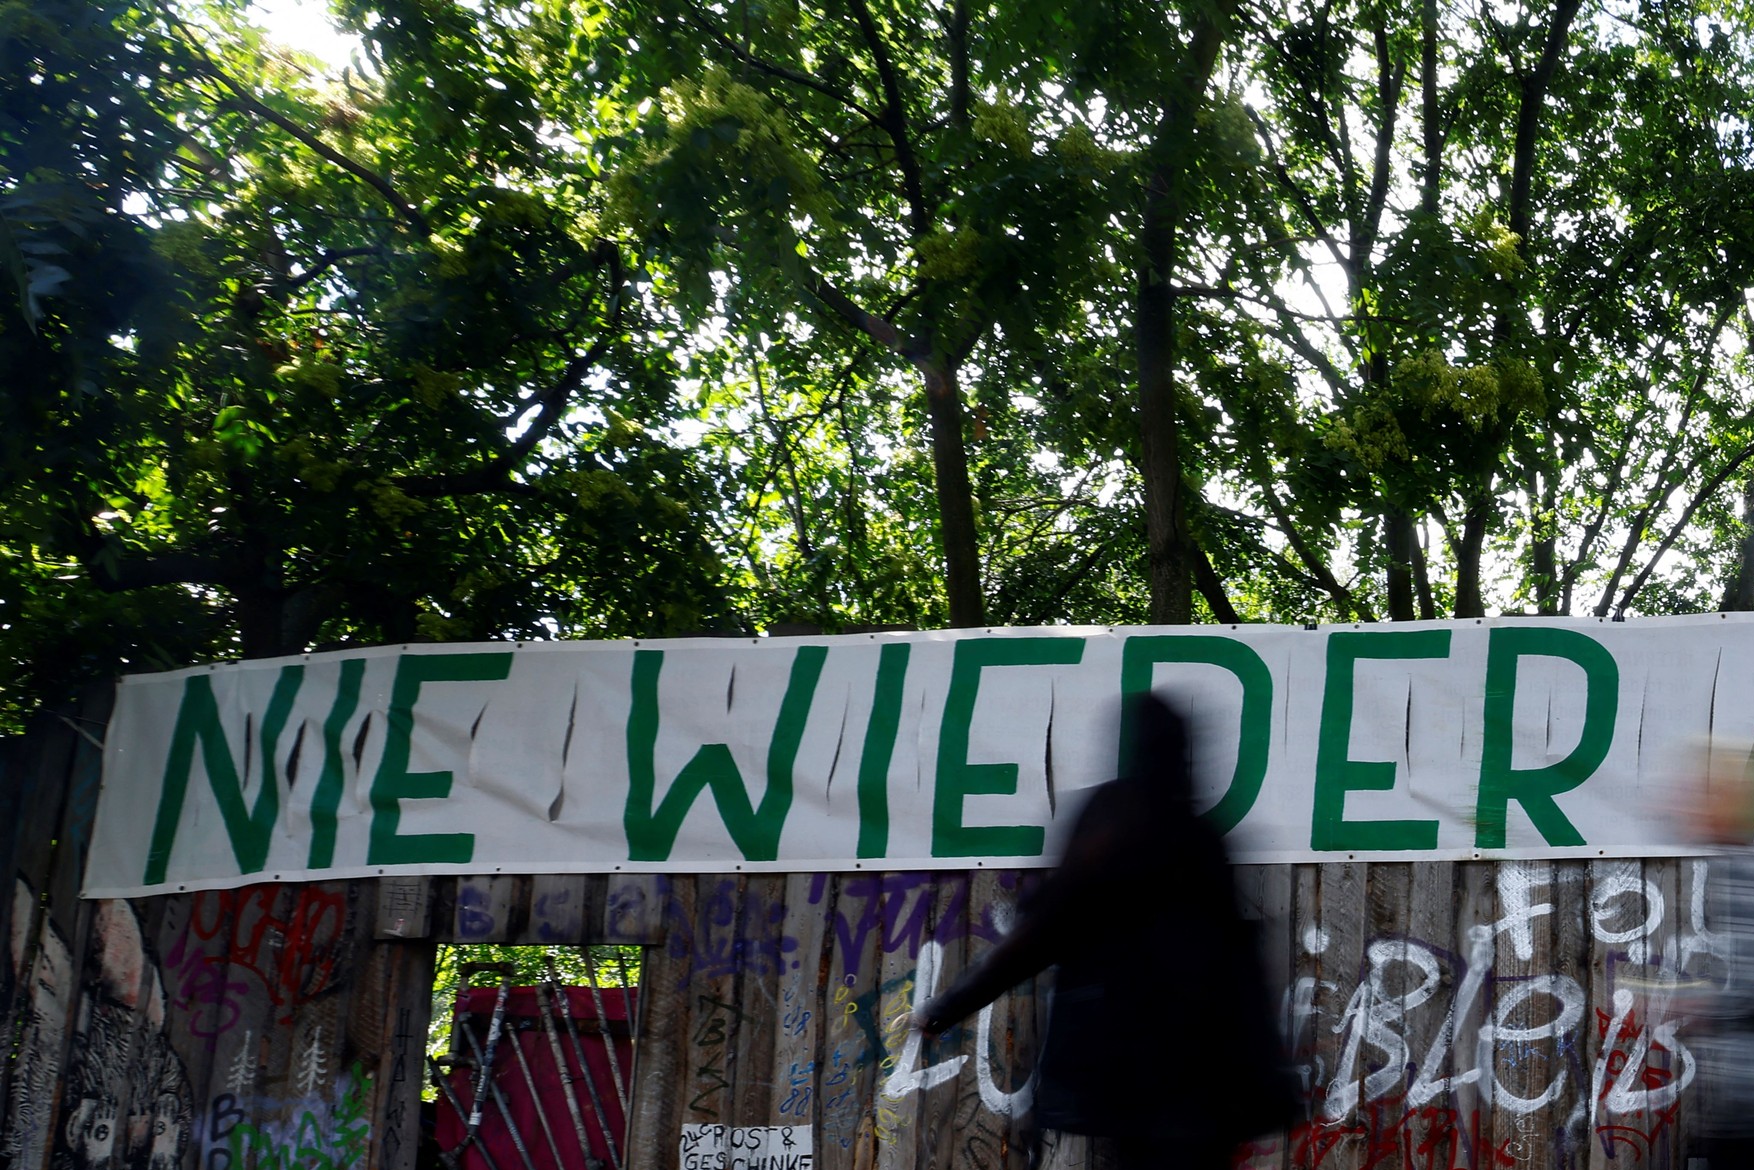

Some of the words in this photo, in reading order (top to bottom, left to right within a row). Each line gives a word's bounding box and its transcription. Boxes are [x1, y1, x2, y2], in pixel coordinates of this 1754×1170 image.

[143, 651, 514, 886] NIE
[621, 627, 1620, 863] WIEDER
[713, 1125, 778, 1150] POST
